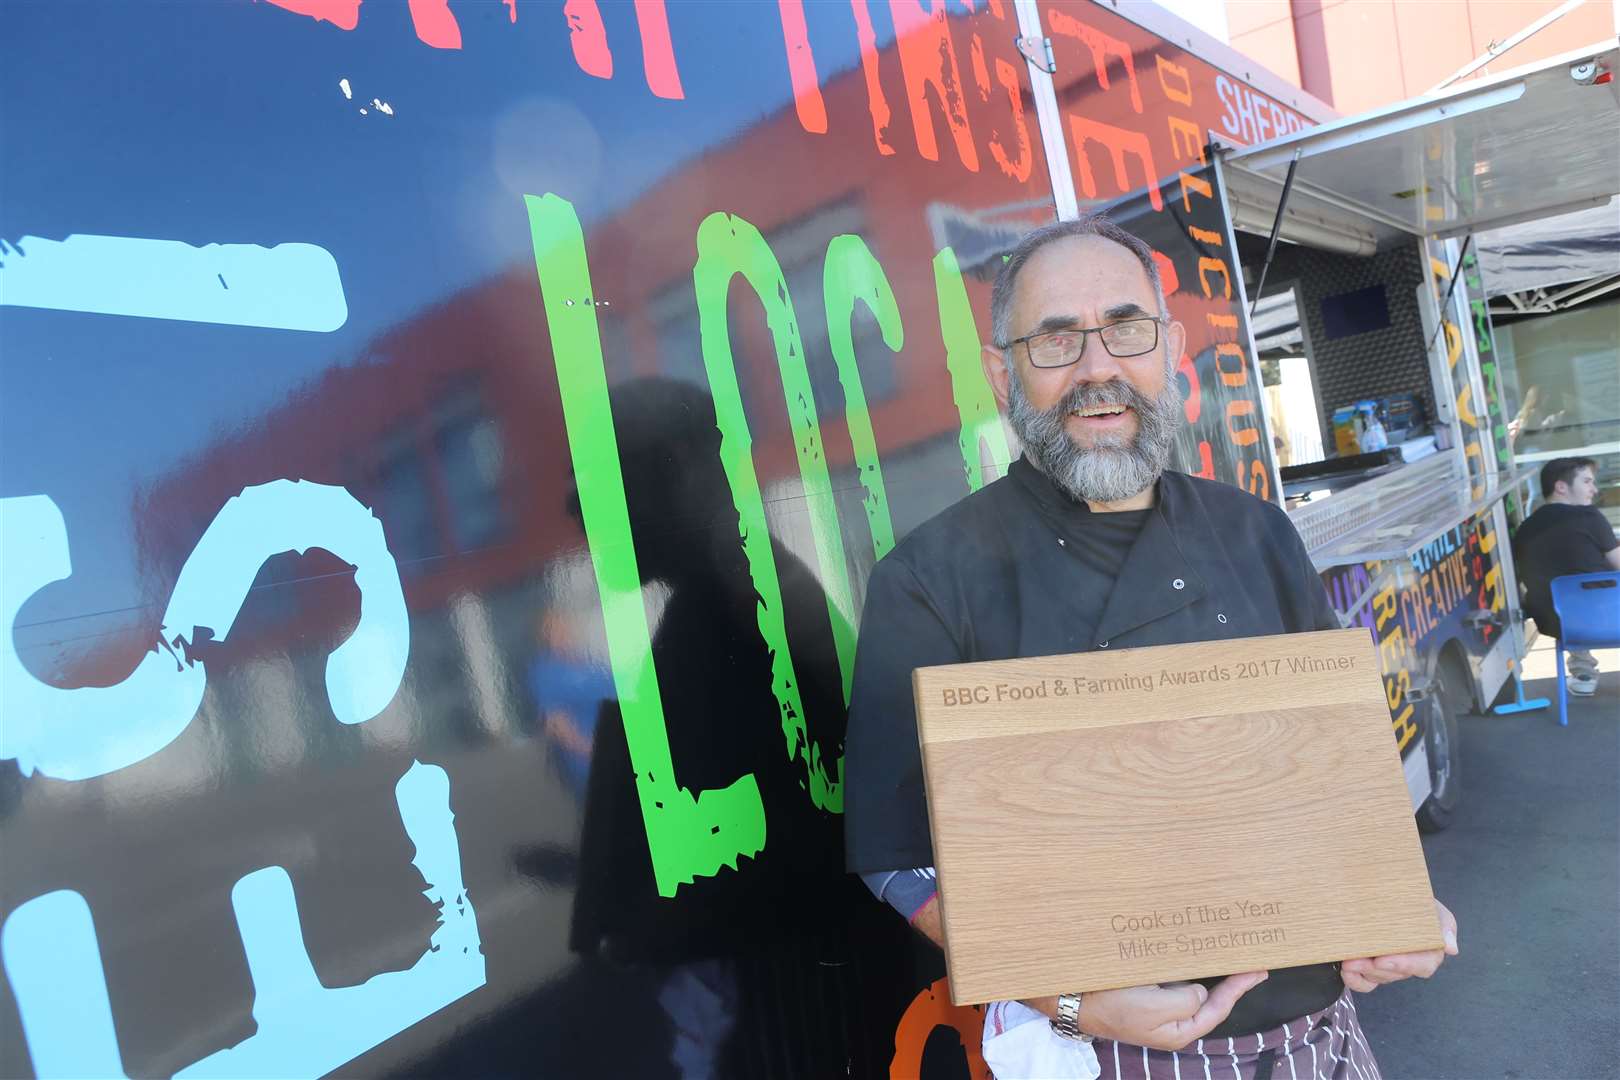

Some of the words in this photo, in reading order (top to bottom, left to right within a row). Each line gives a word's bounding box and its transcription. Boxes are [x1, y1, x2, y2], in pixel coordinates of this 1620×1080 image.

[1155, 54, 1269, 501] DELICIOUS
[1401, 546, 1472, 647] CREATIVE
[942, 685, 990, 707] BBC
[995, 680, 1048, 702] Food
[1054, 679, 1069, 697] &
[1073, 673, 1154, 694] Farming
[1159, 664, 1231, 687] Awards
[1235, 659, 1281, 679] 2017
[1286, 655, 1356, 674] Winner
[1111, 910, 1167, 933] Cook
[1172, 905, 1192, 926] of
[1199, 904, 1230, 924] the
[1236, 900, 1283, 919] Year
[1118, 937, 1168, 961] Mike
[1175, 926, 1287, 957] Spackman
